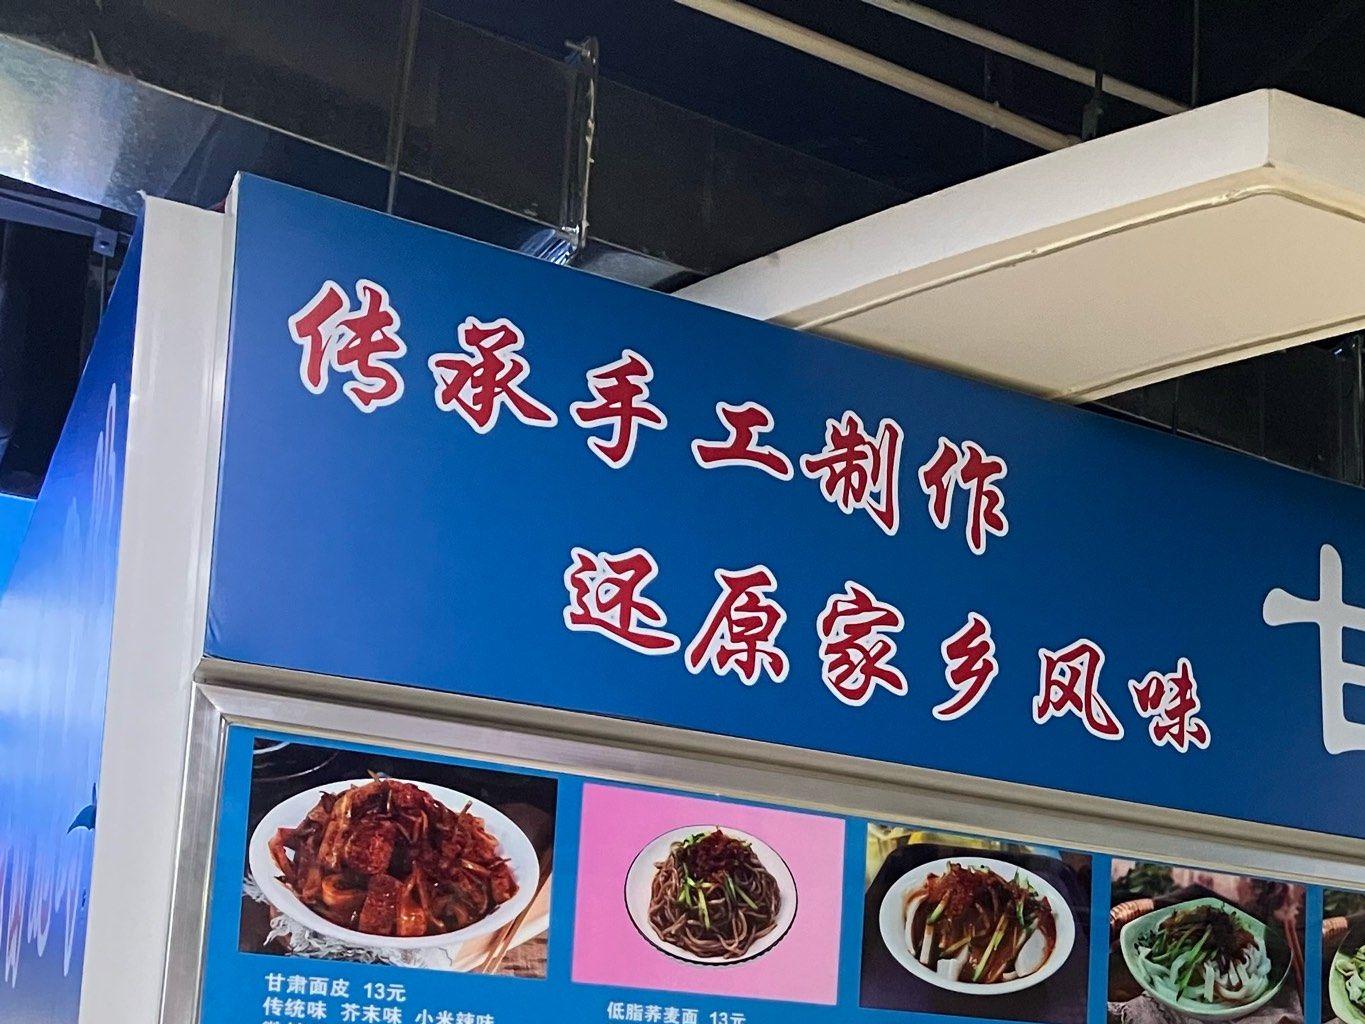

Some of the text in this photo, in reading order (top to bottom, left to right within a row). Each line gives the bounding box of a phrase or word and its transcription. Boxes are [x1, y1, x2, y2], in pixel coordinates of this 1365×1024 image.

[289, 279, 1009, 555] 传承手工制作
[562, 546, 1213, 754] 还原家乡风味
[262, 997, 327, 1019] 传统味
[341, 1003, 402, 1024] 芥末味
[265, 973, 406, 1002] 甘肃面皮 13元
